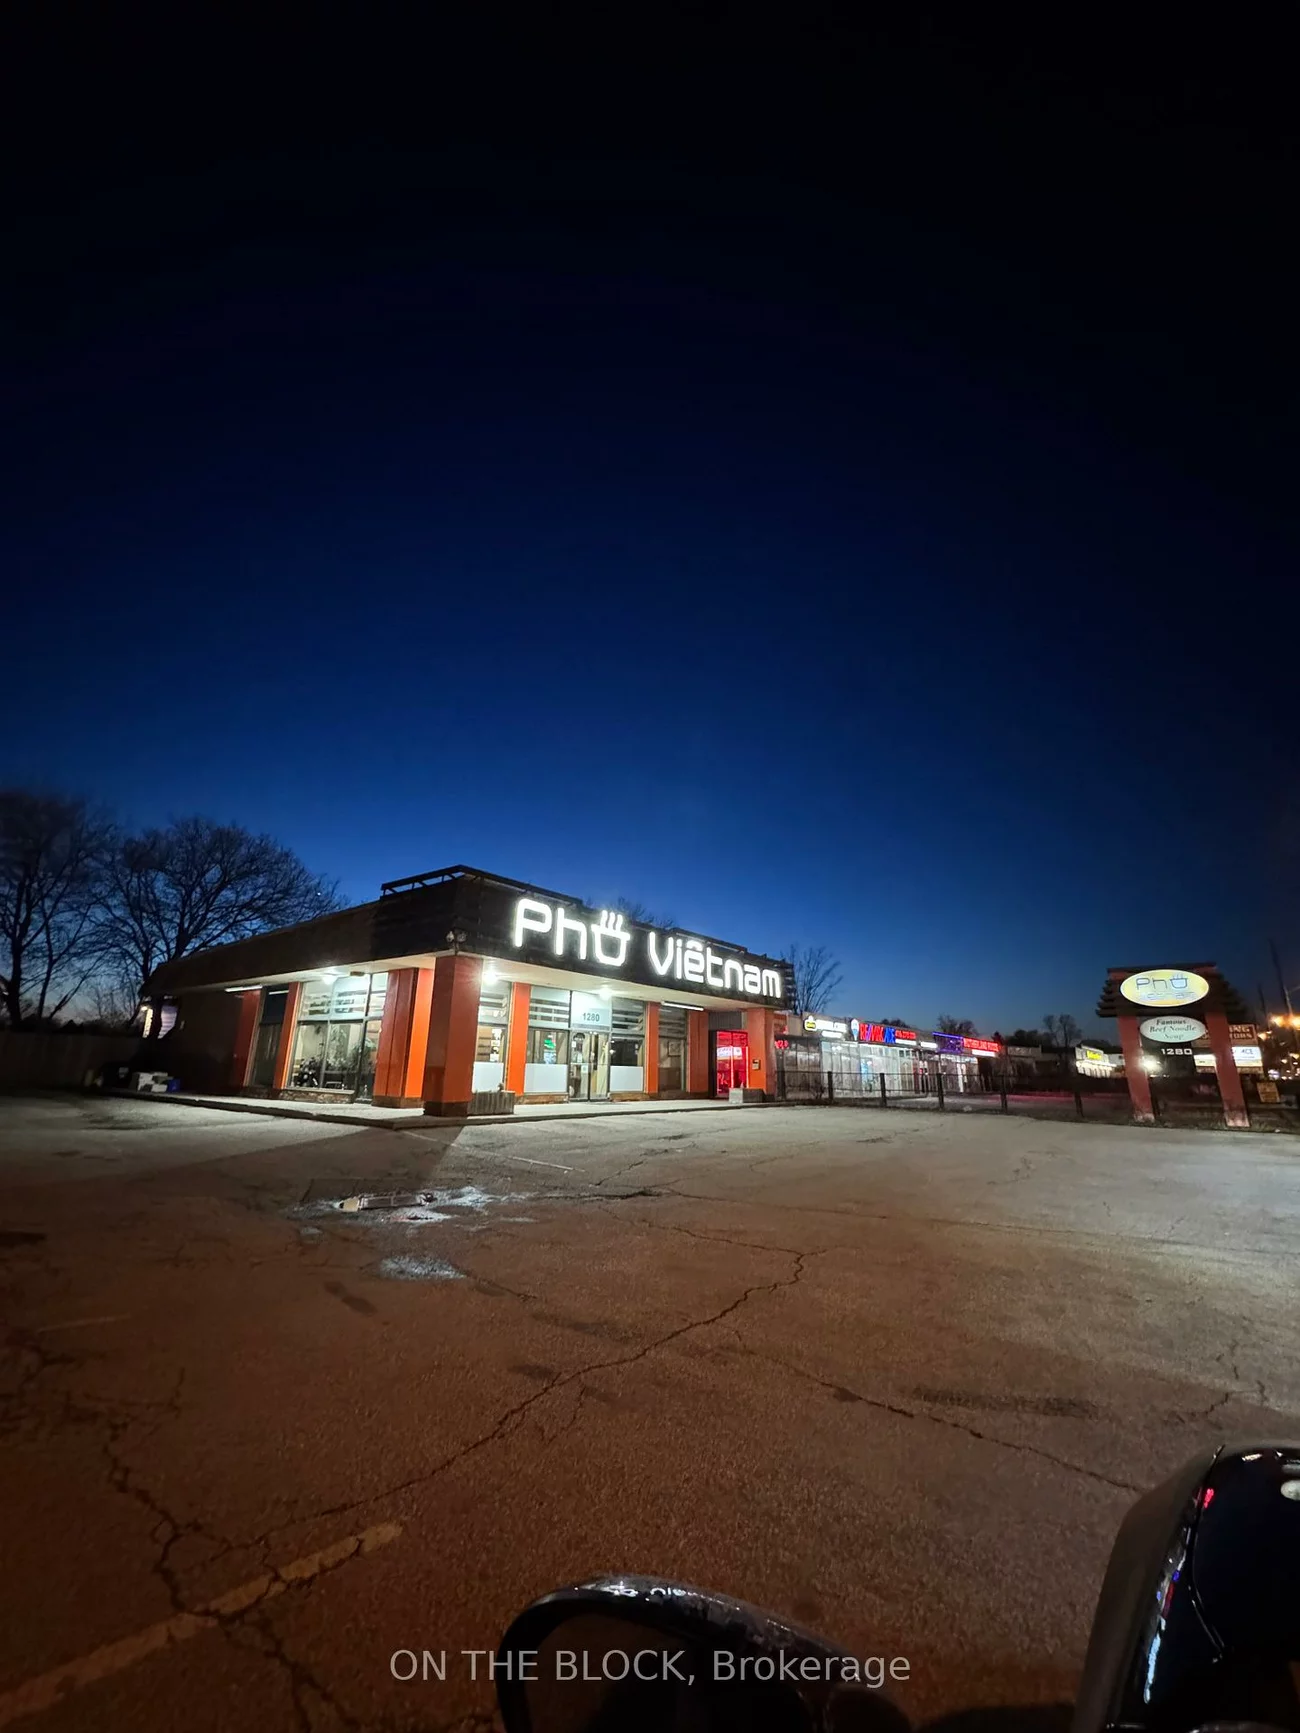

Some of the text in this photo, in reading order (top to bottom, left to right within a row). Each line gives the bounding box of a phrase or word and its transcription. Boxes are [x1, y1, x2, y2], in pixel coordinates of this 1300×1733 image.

[582, 1012, 600, 1023] 1280
[1156, 1018, 1187, 1026] Famous
[1149, 1024, 1197, 1033] Beef Noodle
[1160, 1048, 1193, 1056] 1280
